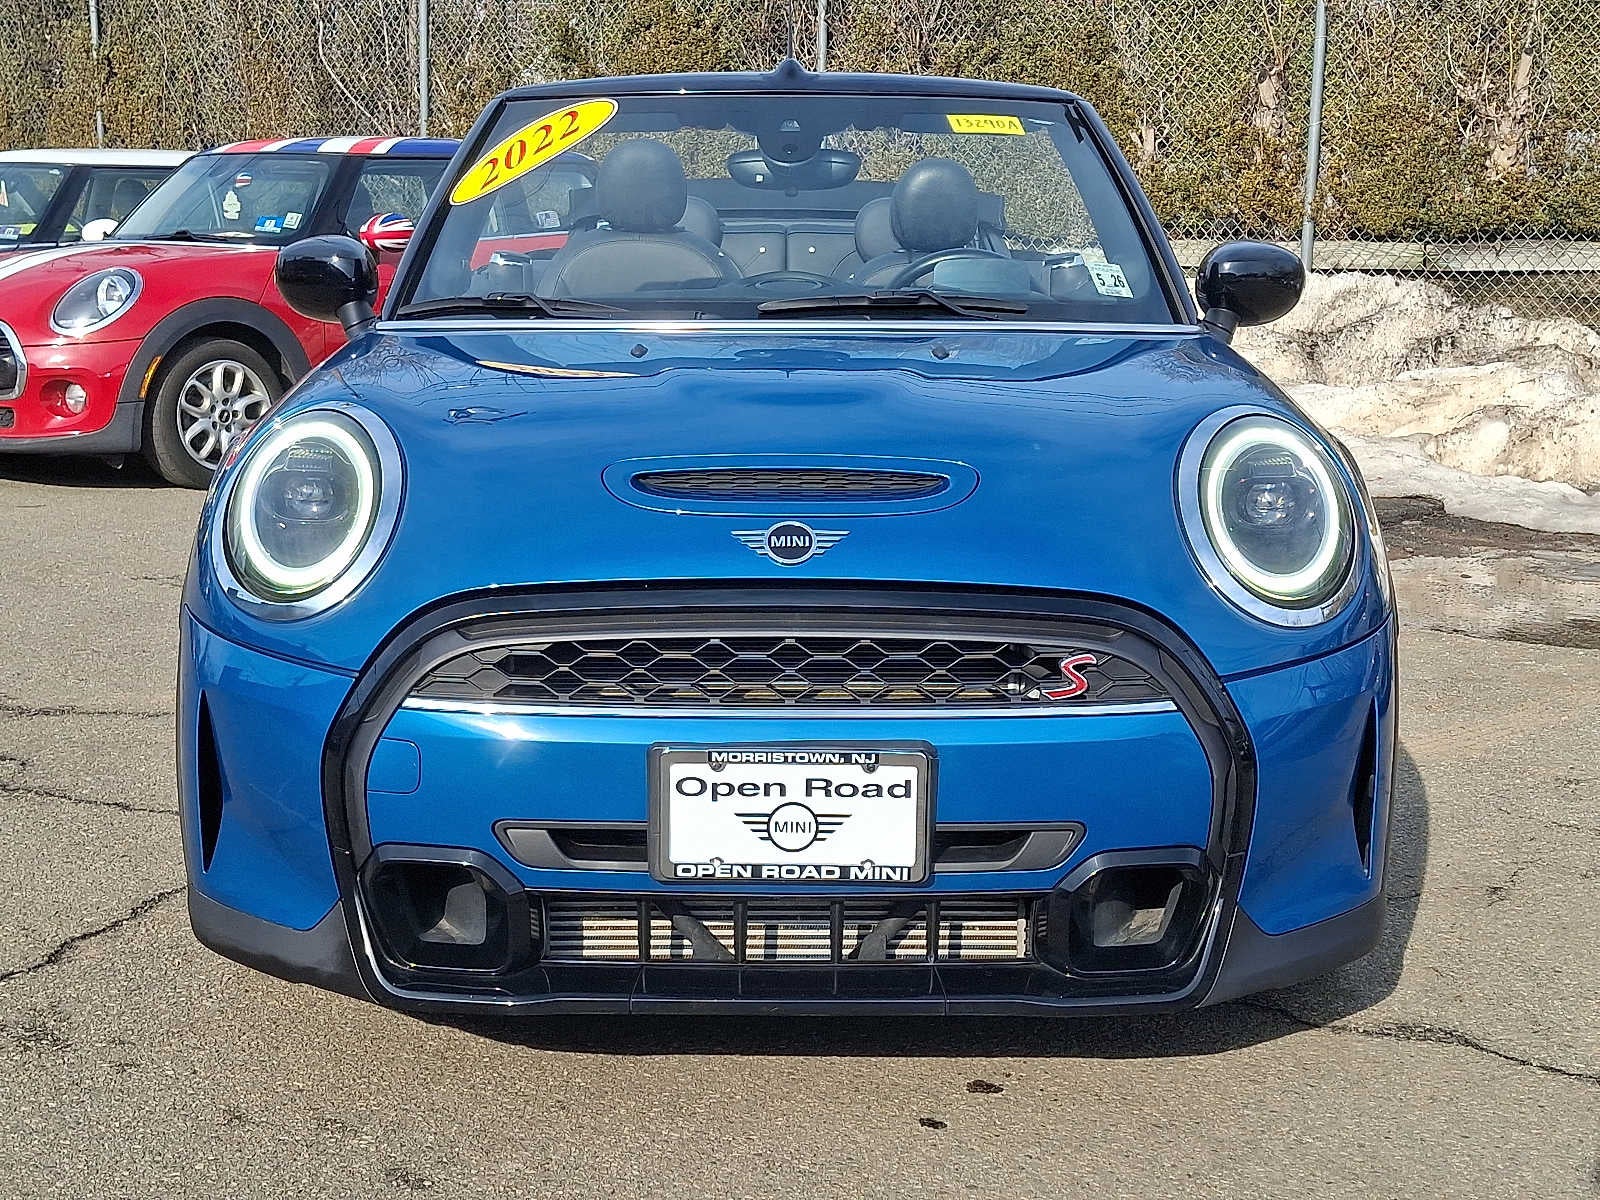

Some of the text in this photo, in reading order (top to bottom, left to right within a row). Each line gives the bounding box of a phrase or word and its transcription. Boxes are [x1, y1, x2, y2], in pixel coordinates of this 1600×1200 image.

[480, 110, 580, 191] 2022
[1096, 273, 1126, 288] 5 26
[770, 535, 810, 548] MINI
[1041, 654, 1097, 700] S
[711, 751, 876, 765] MORRISTOWN, NJ
[675, 776, 912, 802] Open Road
[774, 820, 812, 834] MINI
[676, 863, 909, 881] OPEN ROAD MINI
